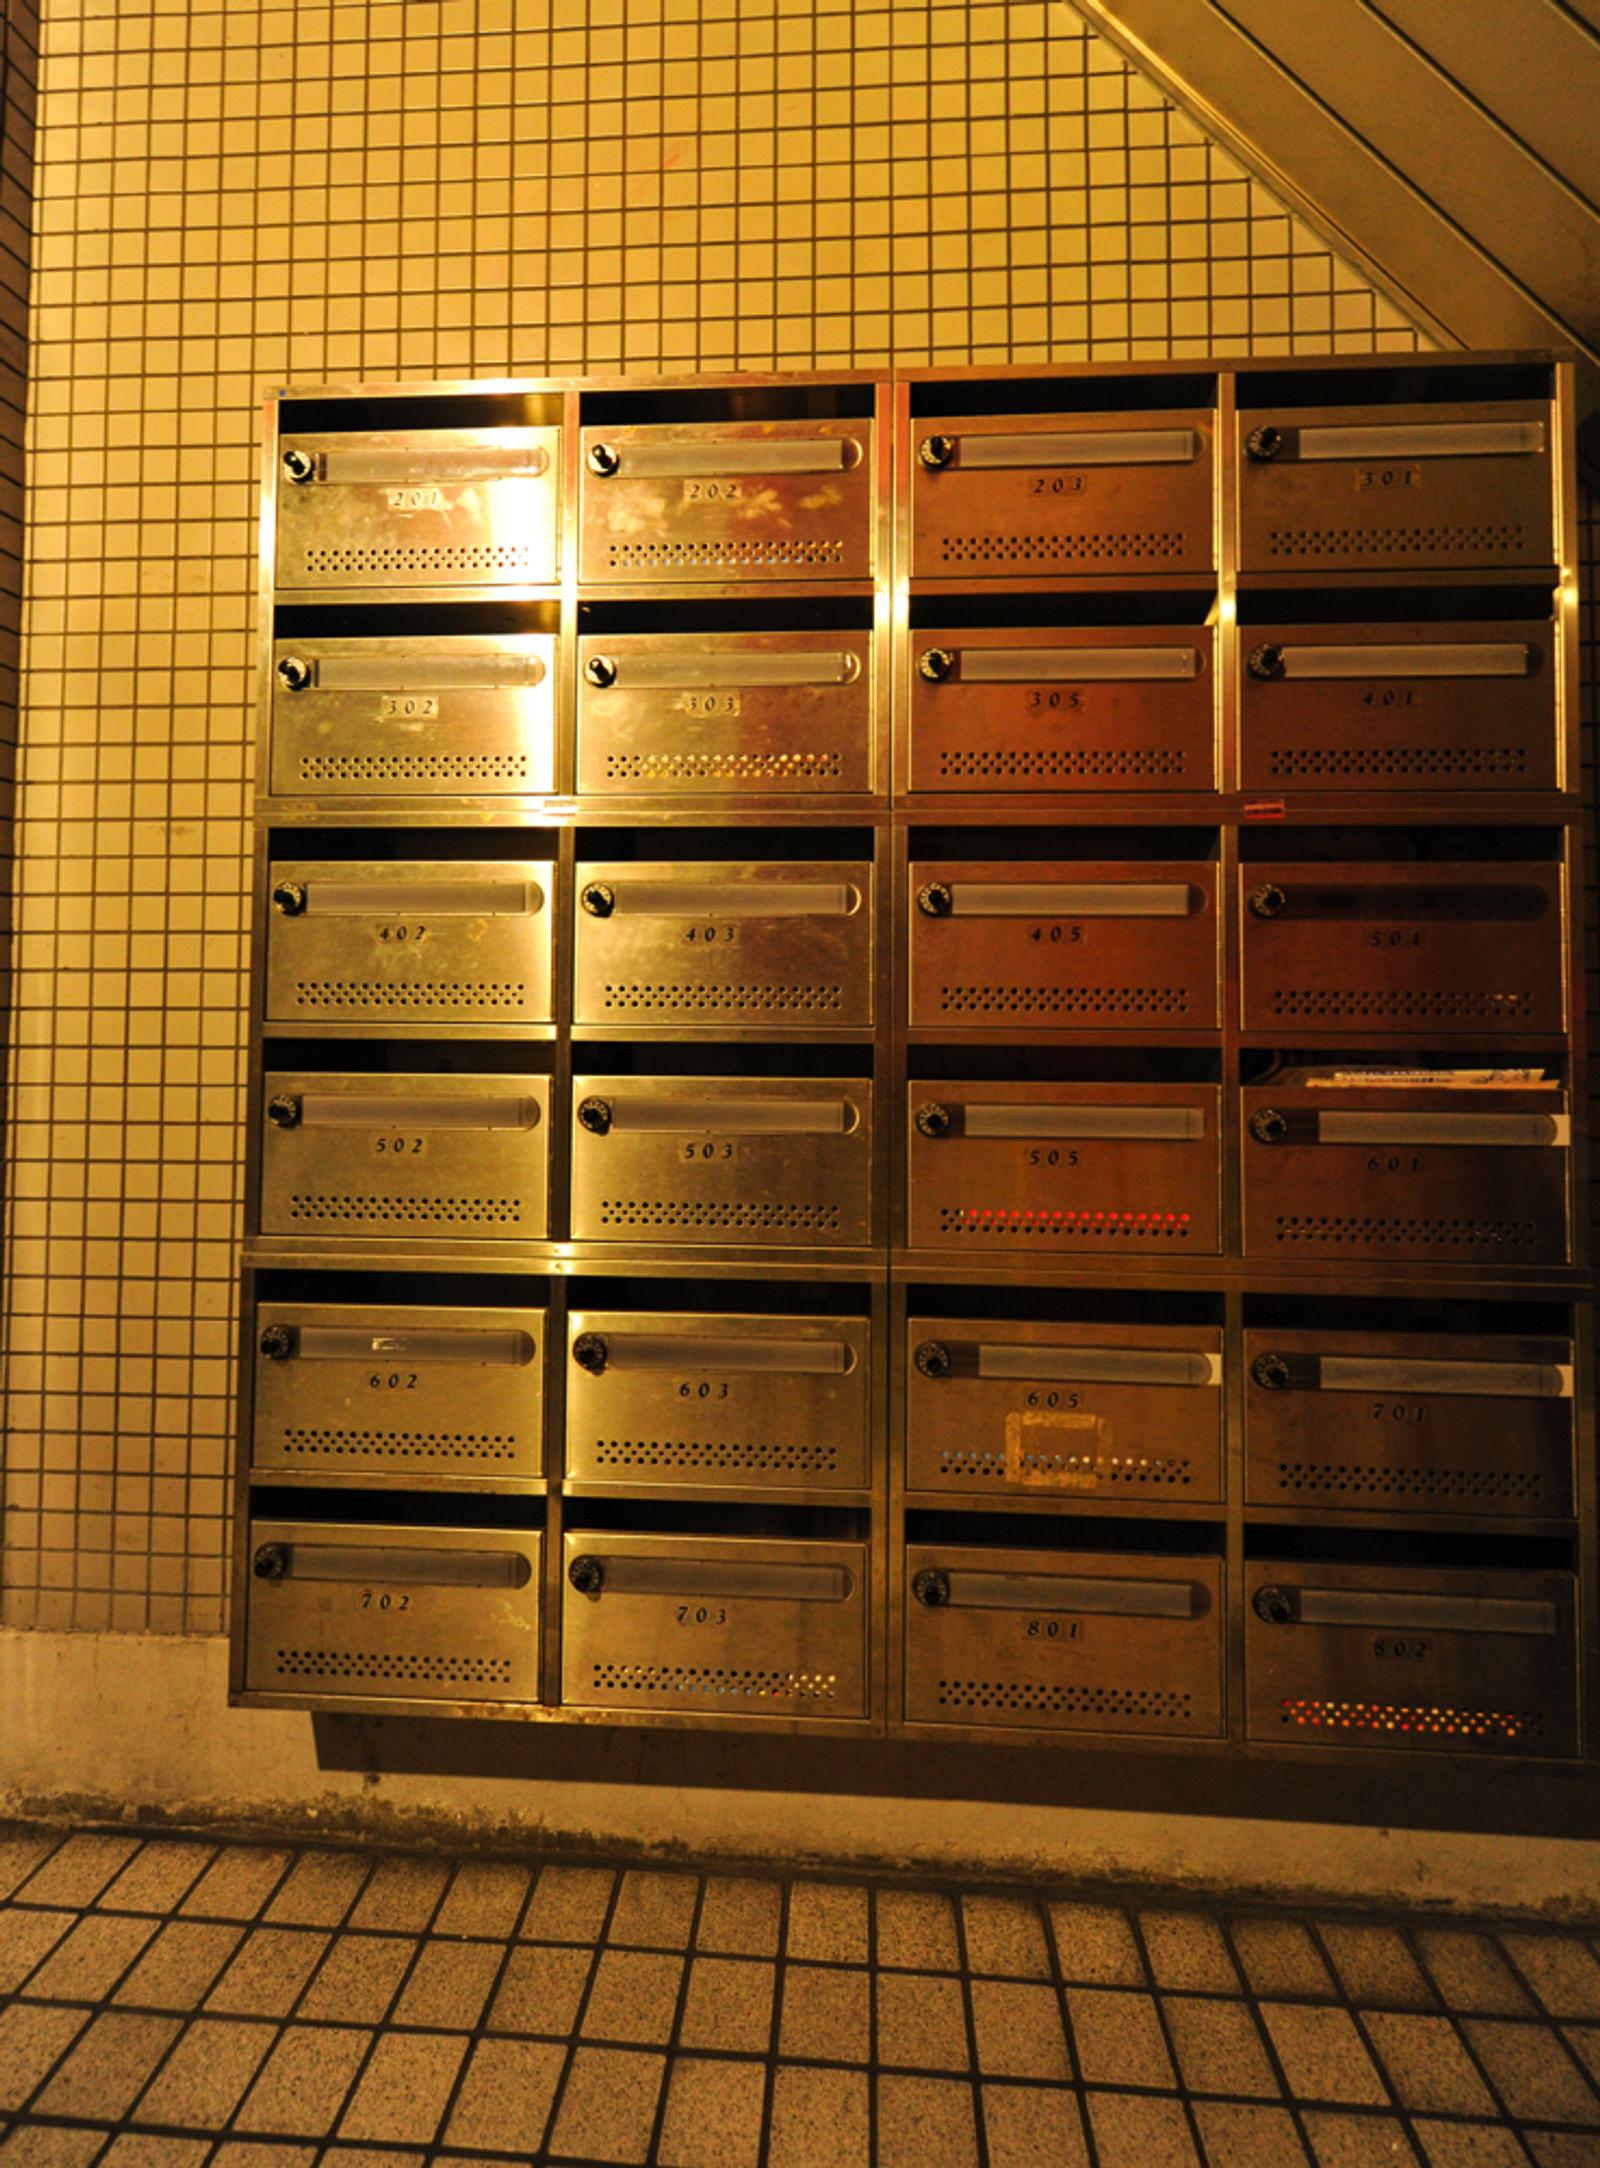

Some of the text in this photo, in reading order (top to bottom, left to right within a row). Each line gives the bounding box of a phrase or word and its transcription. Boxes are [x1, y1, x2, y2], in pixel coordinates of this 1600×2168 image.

[1034, 477, 1083, 493] 203
[1361, 471, 1411, 486] 301
[690, 484, 736, 498] 202
[394, 492, 438, 506] 201
[690, 697, 734, 711] 303
[1032, 693, 1079, 706] 305
[1362, 690, 1413, 705] 401
[388, 700, 433, 714] 302
[380, 926, 425, 940] 402
[686, 928, 734, 941] 403
[1031, 928, 1080, 941] 405
[1370, 932, 1420, 946] 501
[376, 1139, 422, 1153] 502
[684, 1144, 733, 1158] 503
[1029, 1151, 1078, 1165] 505
[1367, 1156, 1419, 1172] 601
[370, 1374, 417, 1389] 602
[679, 1383, 728, 1399] 603
[1027, 1392, 1079, 1408] 605
[1372, 1404, 1423, 1422] 701
[361, 1593, 409, 1610] 702
[677, 1607, 725, 1623] 703
[1027, 1622, 1077, 1638] 801
[1374, 1641, 1426, 1658] 802
